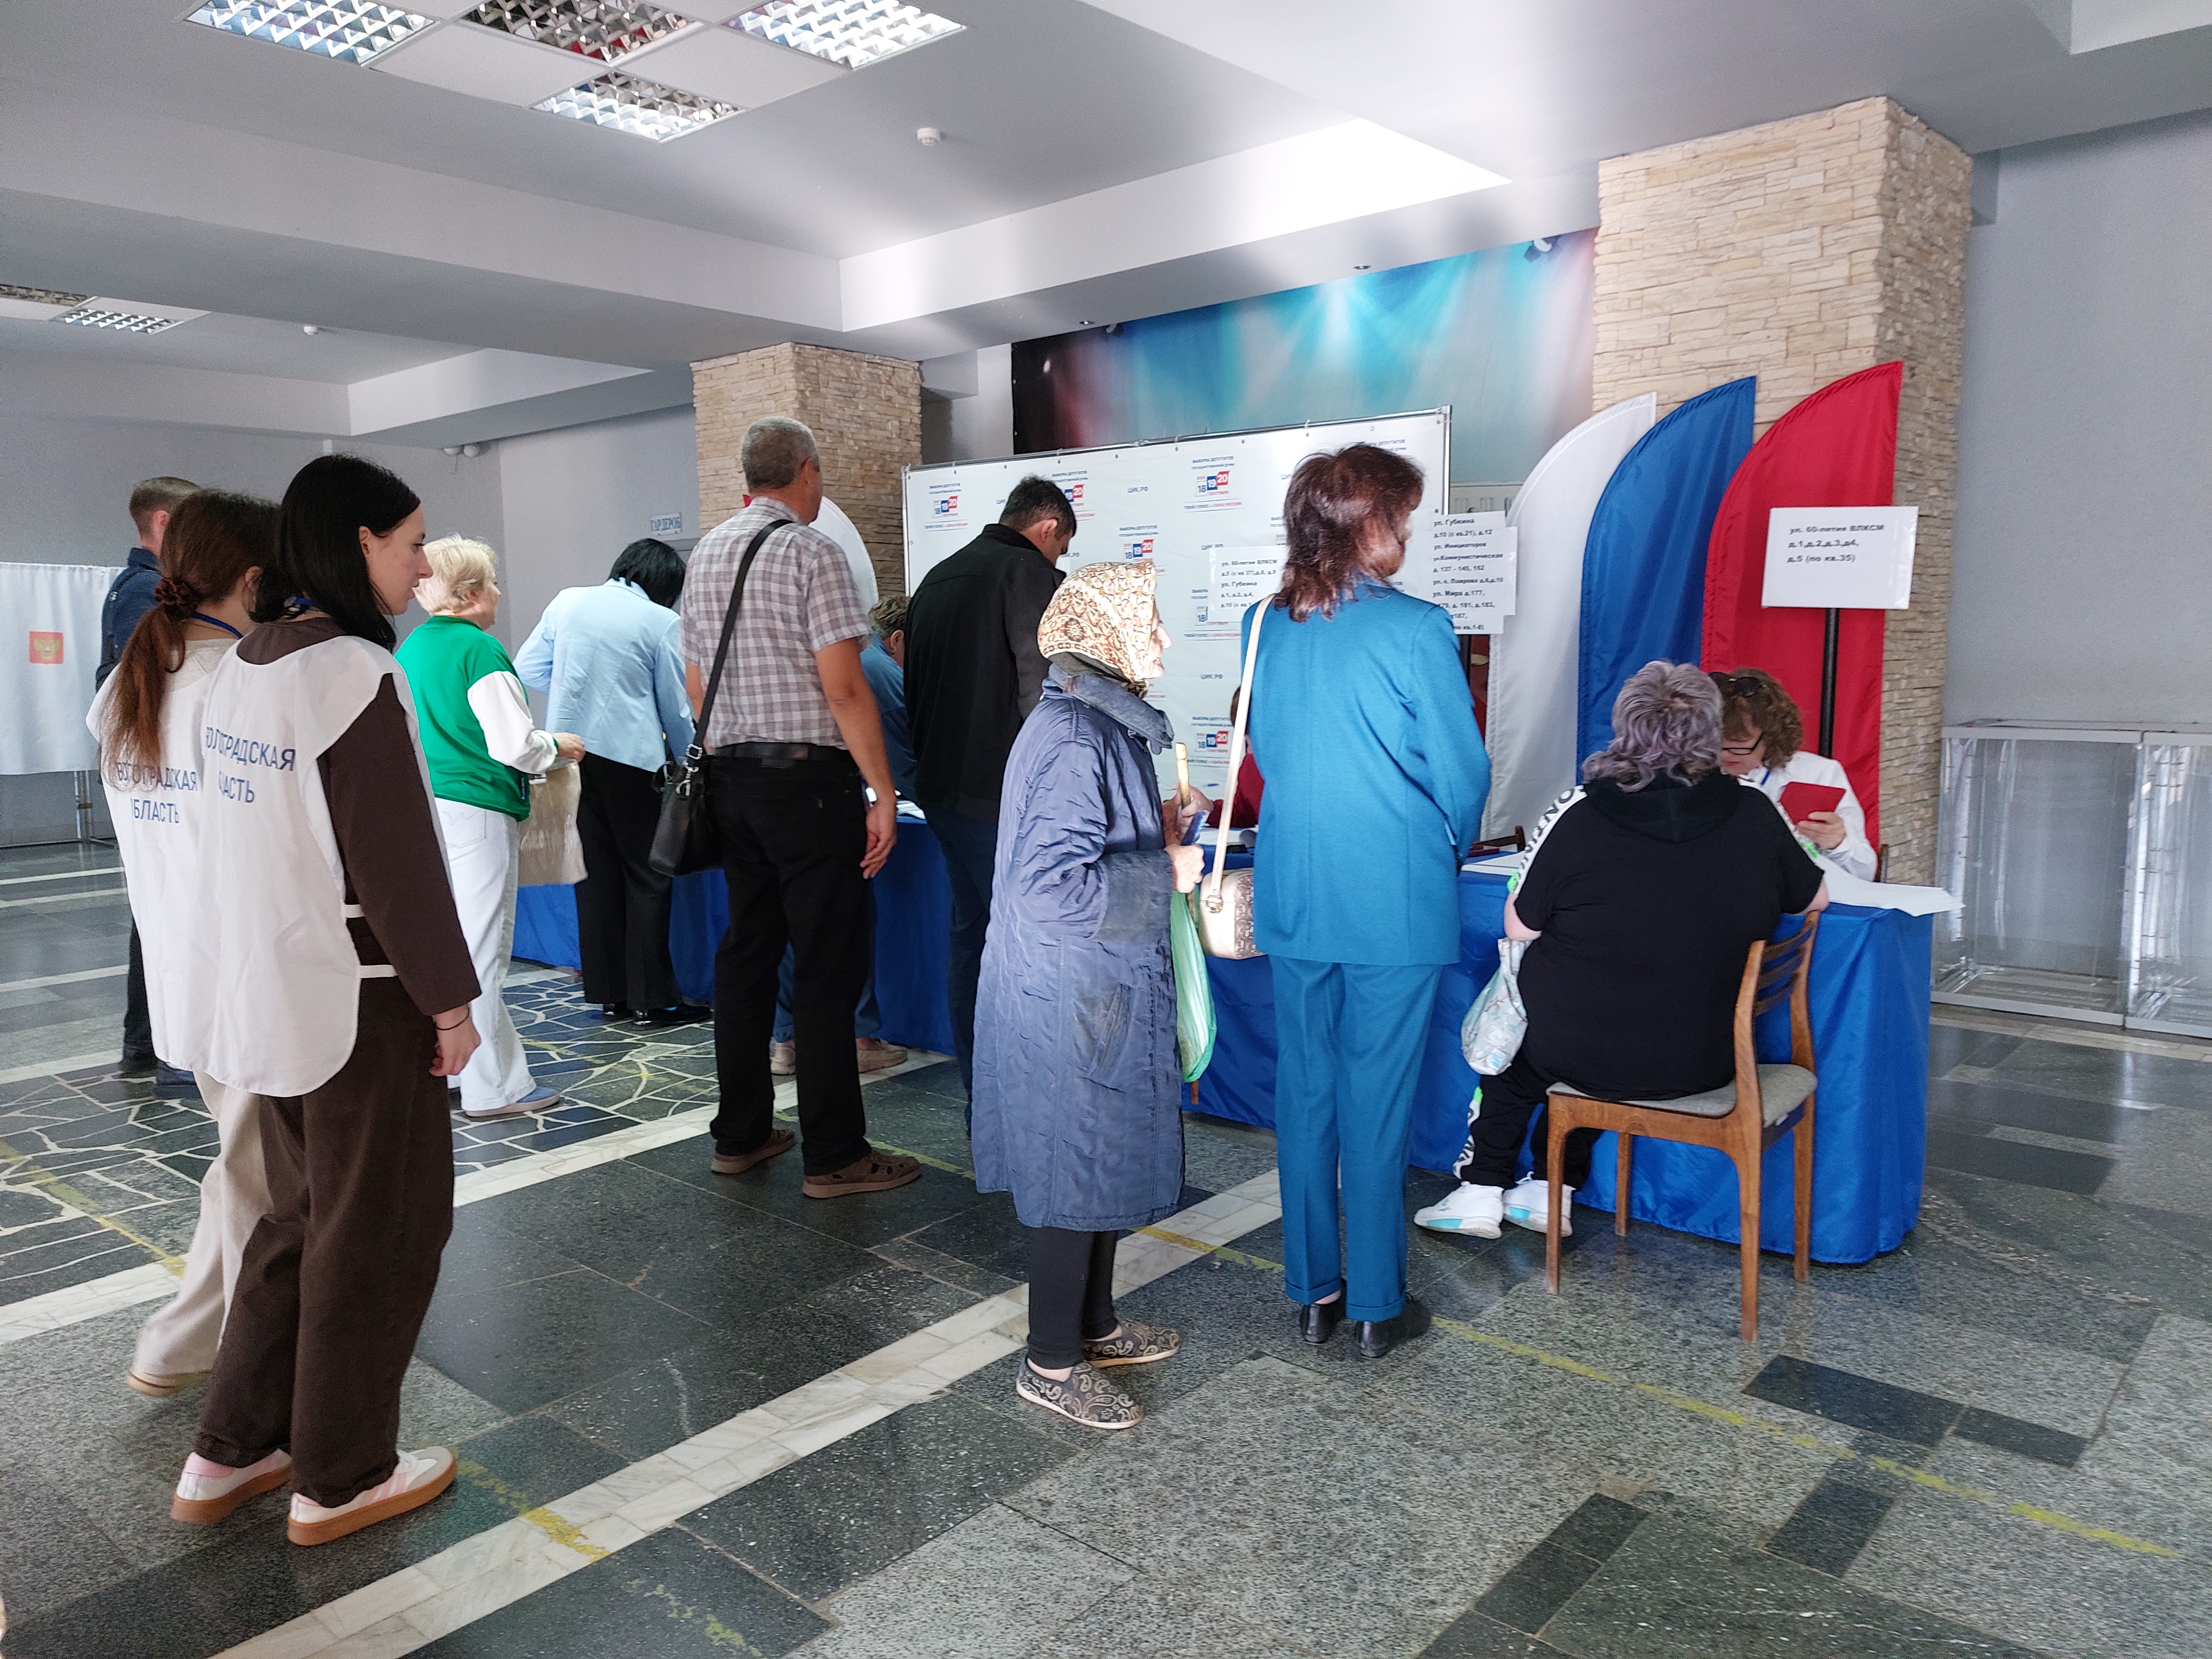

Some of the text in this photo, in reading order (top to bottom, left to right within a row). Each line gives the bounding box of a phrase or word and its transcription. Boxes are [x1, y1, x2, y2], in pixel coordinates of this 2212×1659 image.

[1217, 474, 1228, 483] 20
[1207, 479, 1216, 488] 19
[1198, 485, 1206, 493] 18
[1142, 542, 1153, 551] 20
[1197, 614, 1206, 622] 18
[1207, 737, 1216, 746] 19
[1217, 733, 1228, 742] 20
[1198, 741, 1206, 749] 18
[131, 797, 180, 824] БЛАСТЬ
